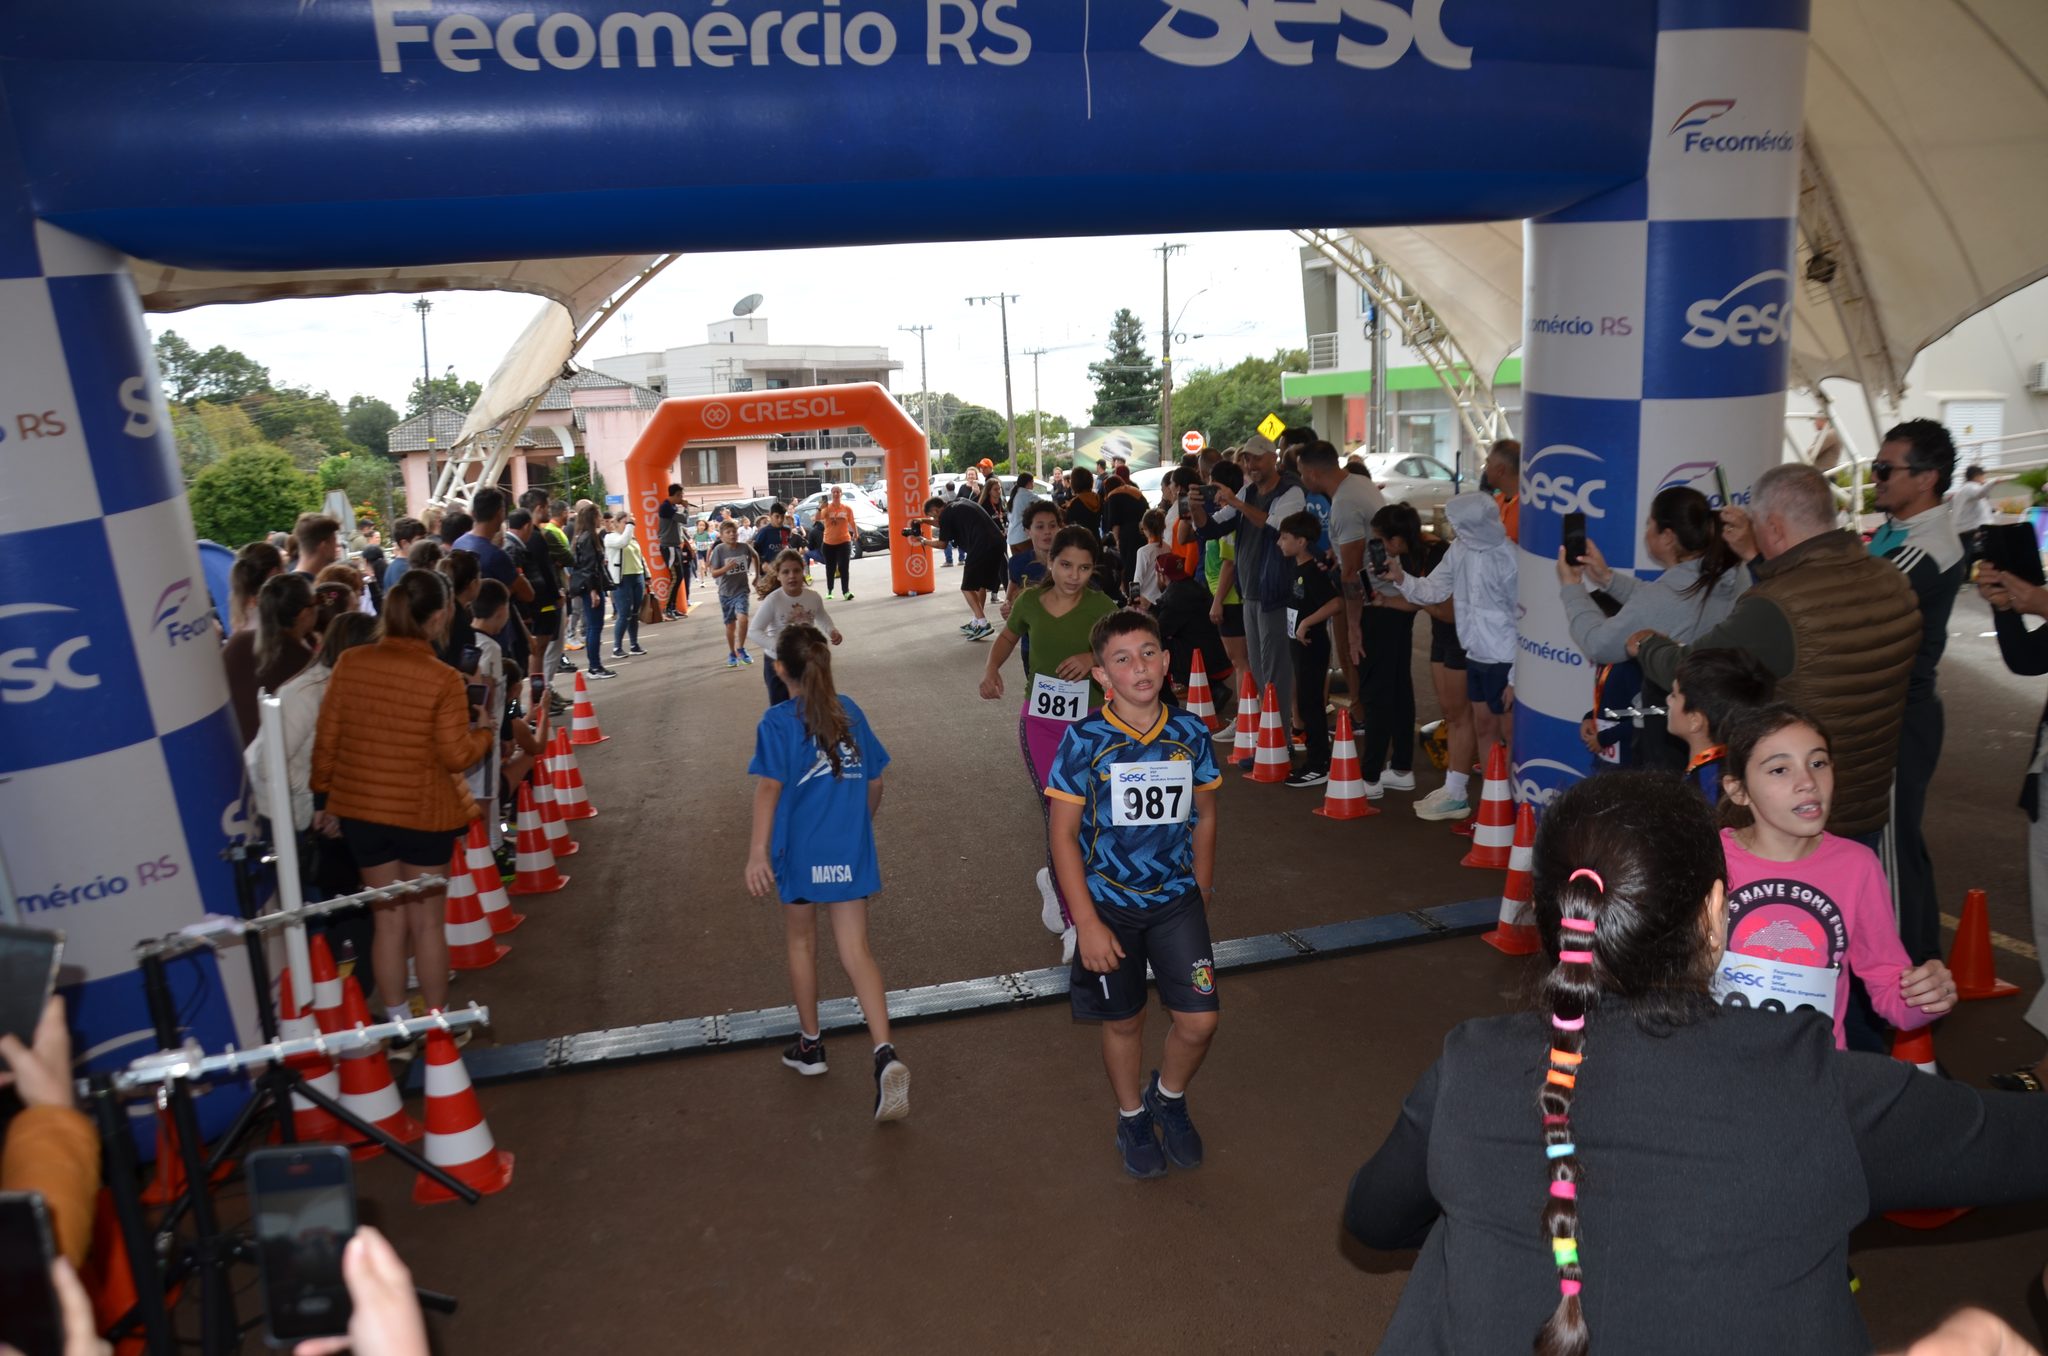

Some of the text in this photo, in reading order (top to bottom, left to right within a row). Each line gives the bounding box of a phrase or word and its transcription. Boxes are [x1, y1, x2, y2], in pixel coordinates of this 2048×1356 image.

[373, 0, 1033, 73] Fecomércio RS
[1600, 316, 1633, 336] RS
[739, 396, 846, 423] CRESOL
[16, 410, 68, 441] RS
[1037, 692, 1079, 718] 981
[1122, 785, 1184, 821] 987
[137, 854, 180, 887] RS
[811, 864, 853, 884] MAYSA
[1740, 883, 1845, 949] HAVE SOME FUN
[1723, 967, 1765, 988] Sesc
